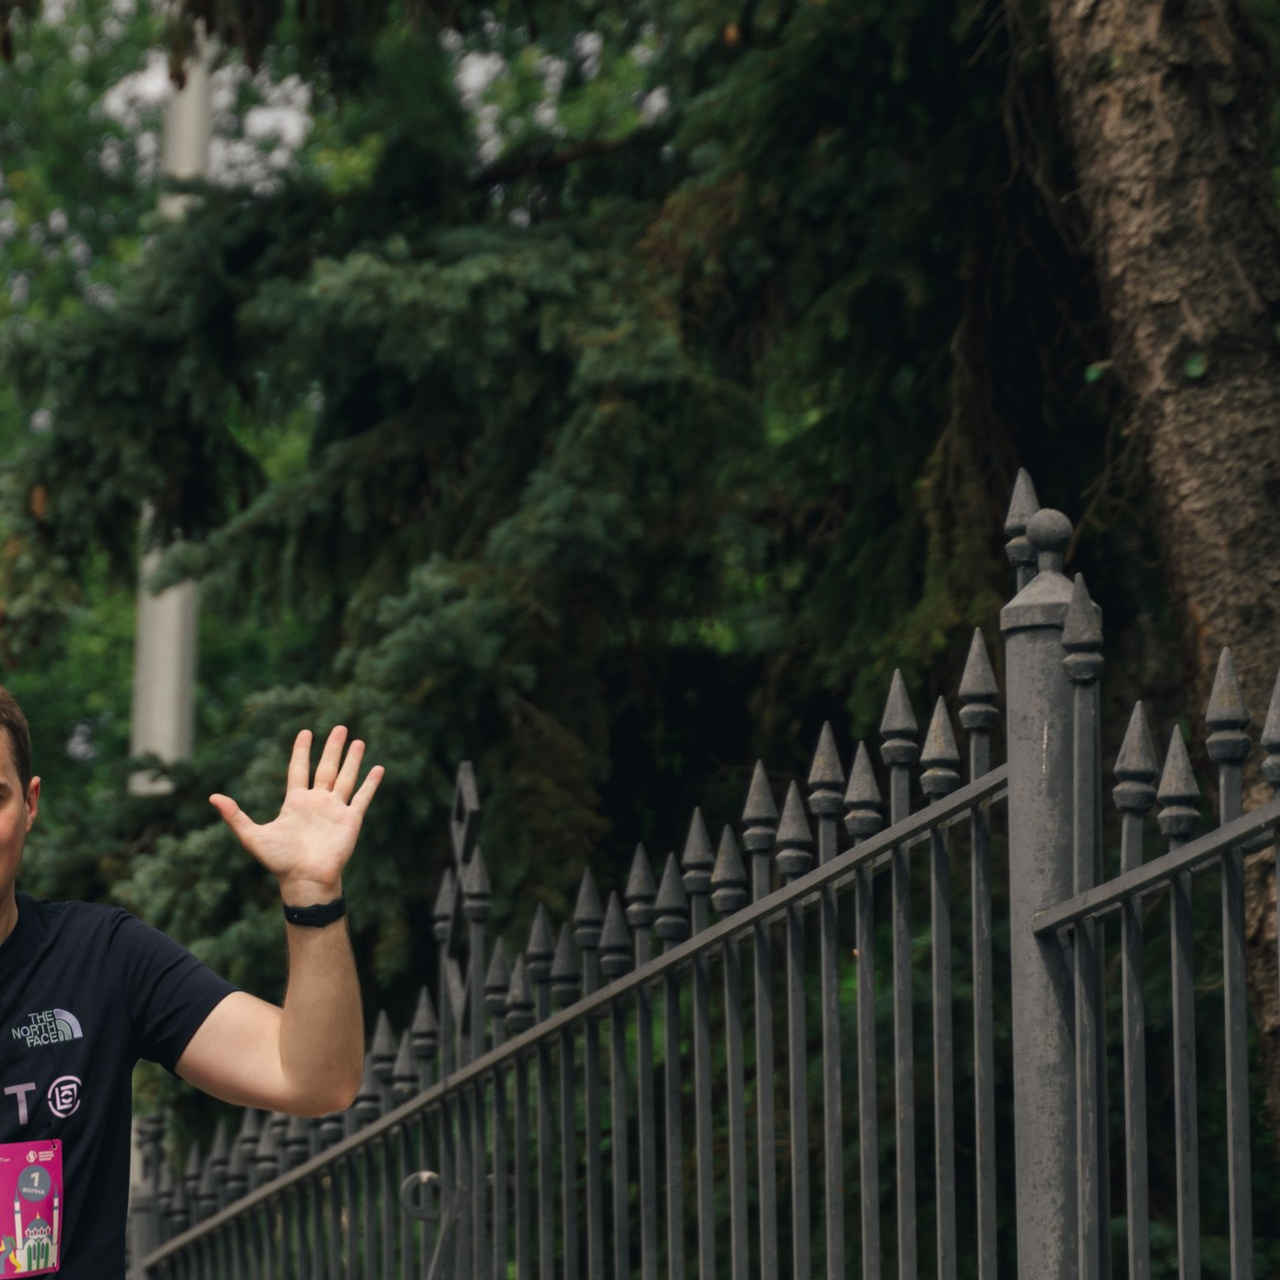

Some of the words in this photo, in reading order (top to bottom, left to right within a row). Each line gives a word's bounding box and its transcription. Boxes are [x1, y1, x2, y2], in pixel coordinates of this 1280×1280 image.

[28, 1010, 54, 1025] THE
[11, 1021, 57, 1039] NORTH
[26, 1032, 59, 1048] FACE
[30, 1172, 40, 1187] 1
[22, 1186, 46, 1195] ВОЛНА
